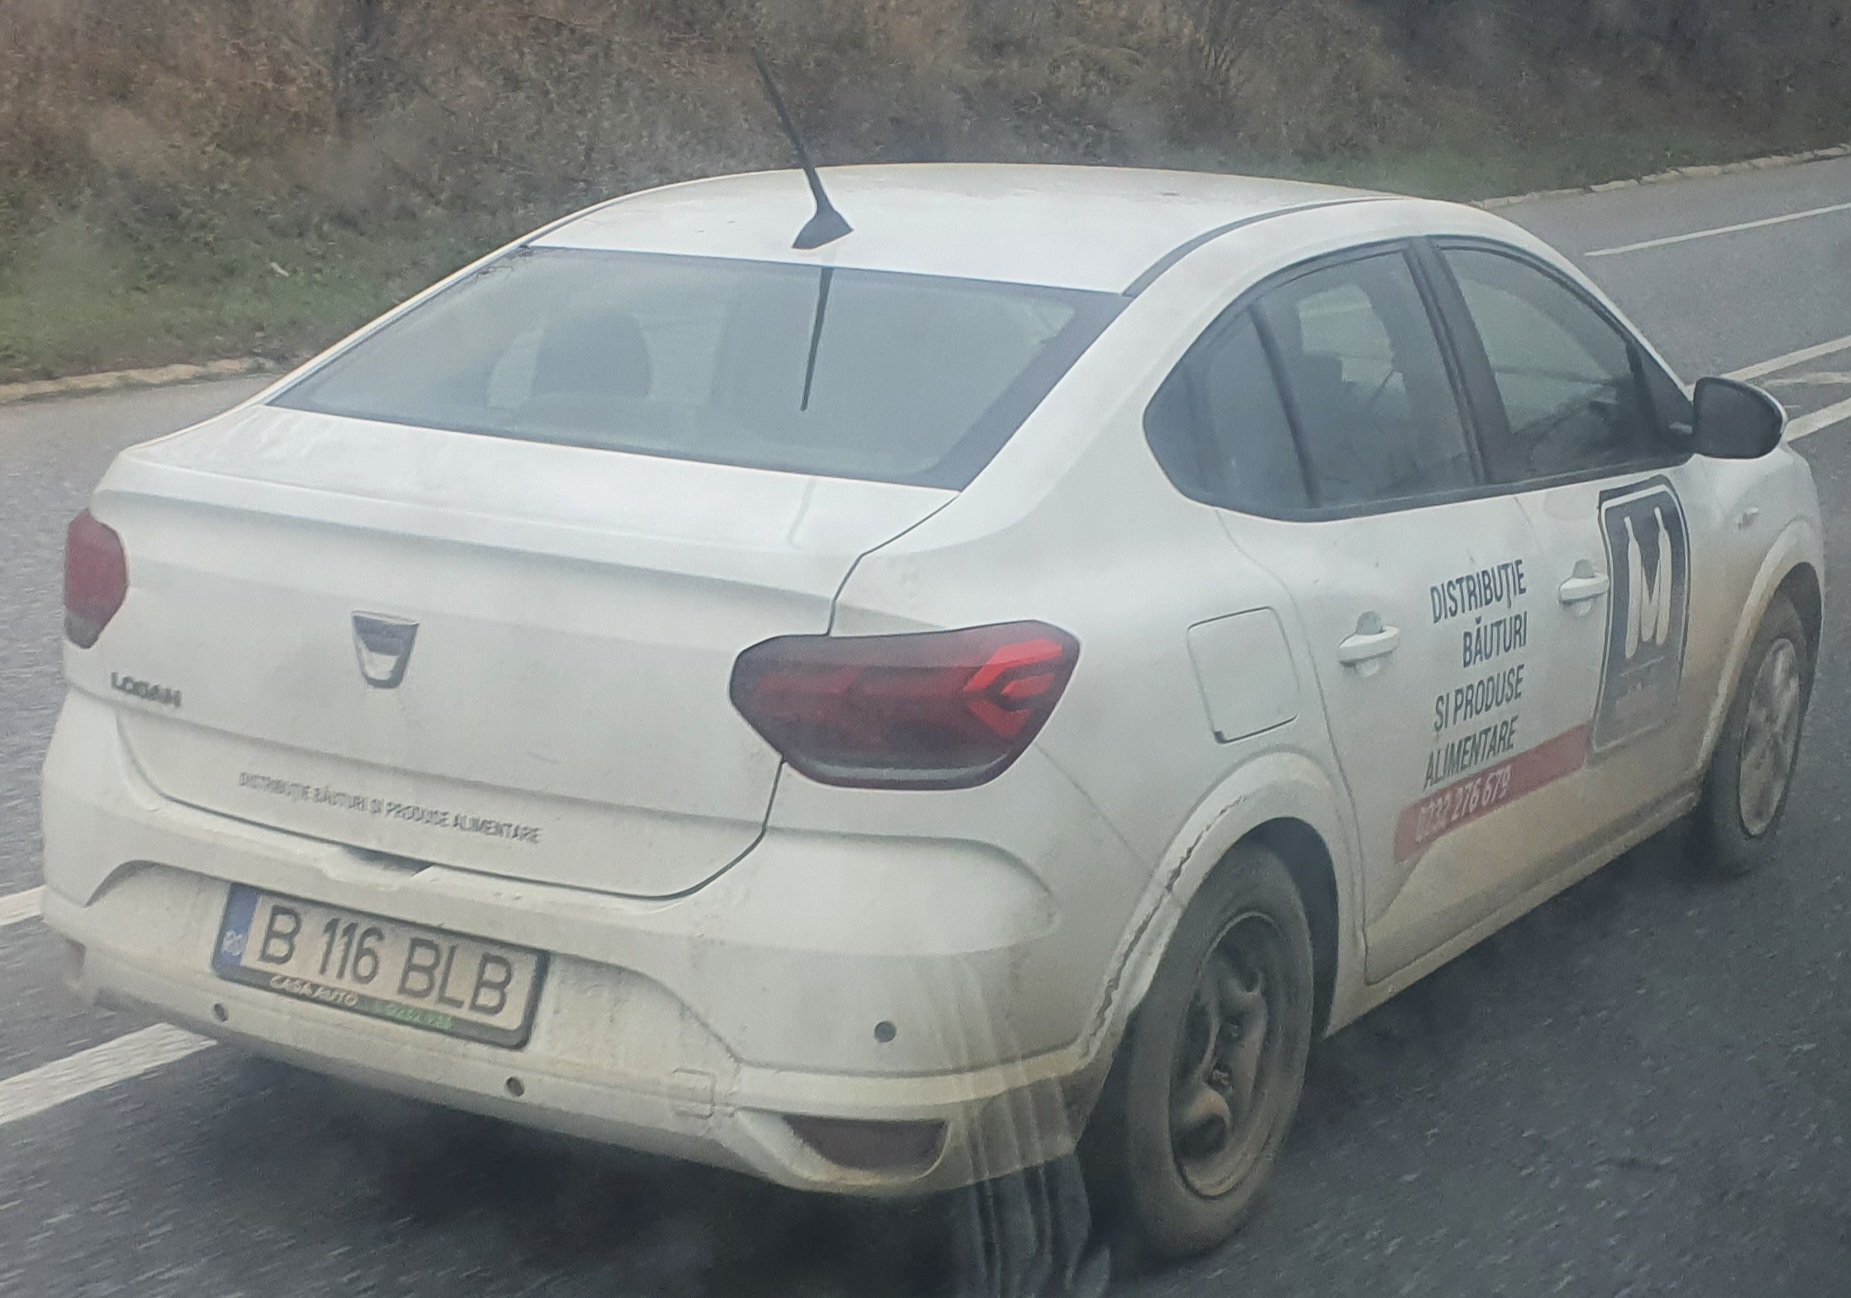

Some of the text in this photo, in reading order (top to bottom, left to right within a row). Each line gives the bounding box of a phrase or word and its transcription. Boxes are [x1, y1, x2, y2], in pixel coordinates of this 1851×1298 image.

[1430, 559, 1526, 624] DISTRIBUȚIE
[1463, 611, 1527, 668] BĂUTURI
[111, 671, 182, 706] LOGAN
[1452, 663, 1525, 725] PRODUSE
[1423, 714, 1519, 791] ALIMENTARE
[453, 813, 542, 844] ALIMENTARE
[1451, 777, 1481, 822] 276
[258, 904, 514, 1016] B 116 BLB
